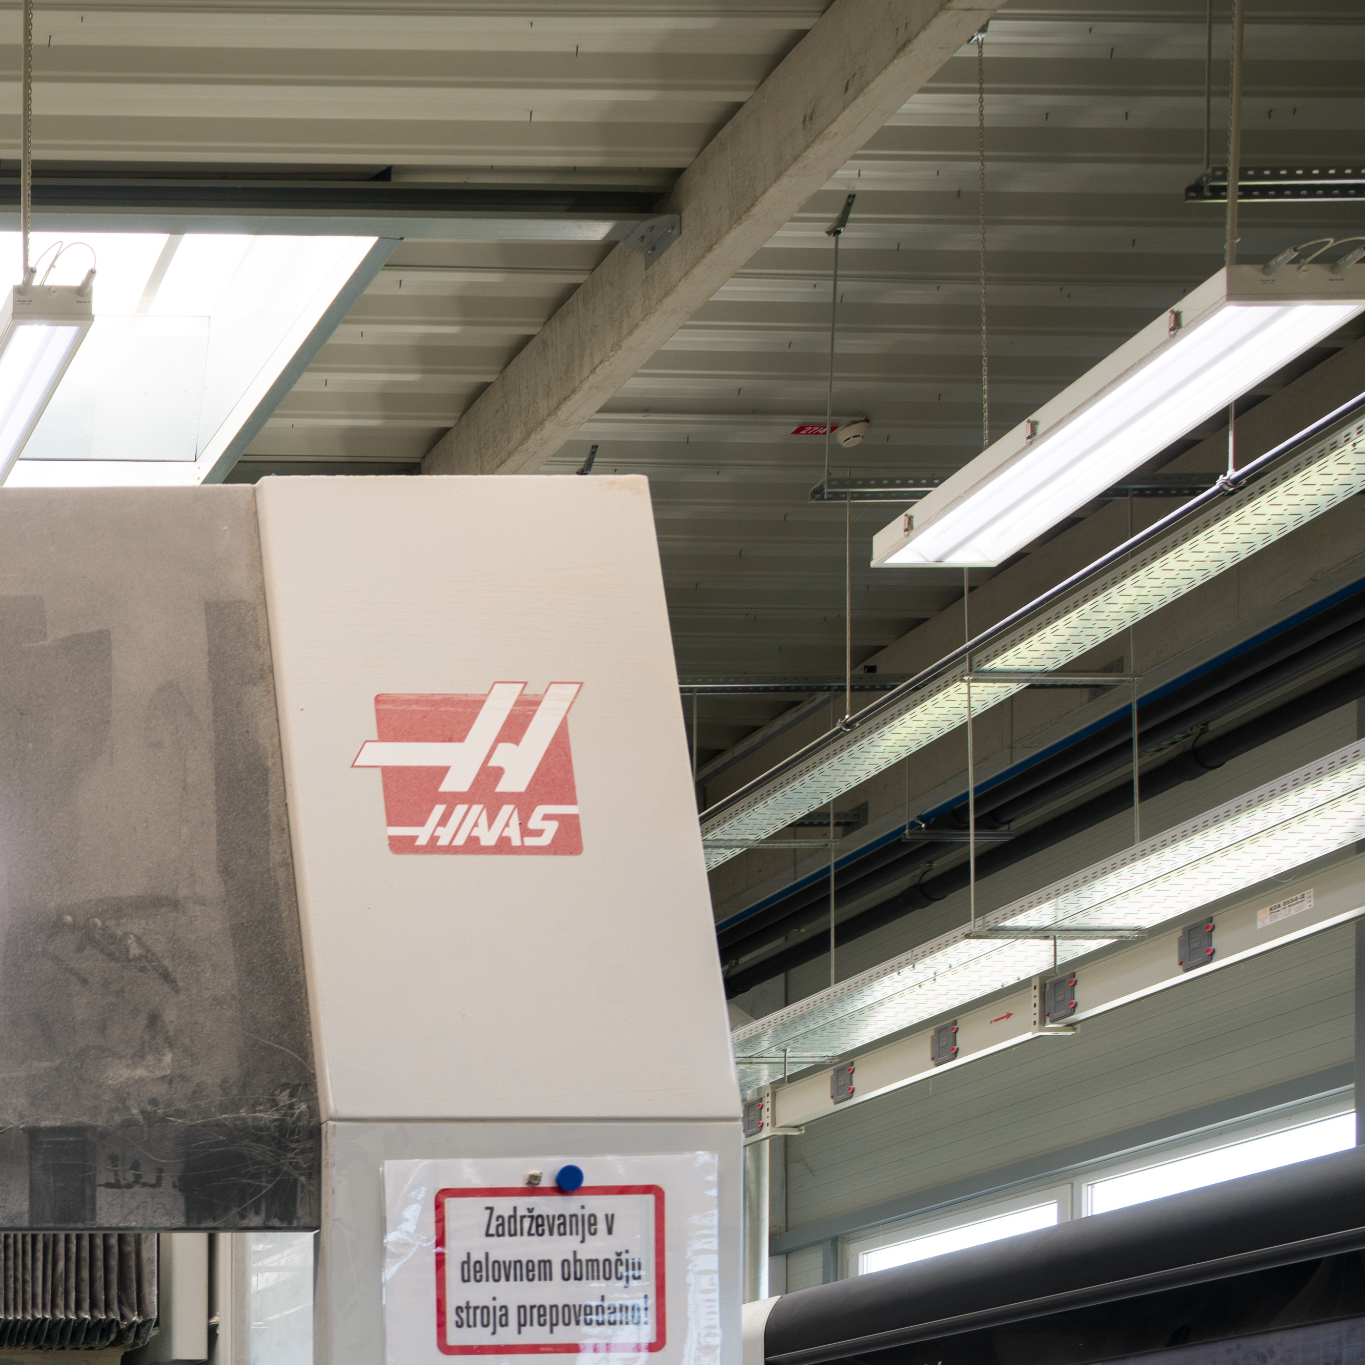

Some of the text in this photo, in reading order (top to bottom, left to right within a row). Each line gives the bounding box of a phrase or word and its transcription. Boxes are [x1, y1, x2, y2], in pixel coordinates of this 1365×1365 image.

[387, 804, 579, 846] HAAS
[484, 1205, 616, 1244] Zadrževanje v
[460, 1249, 642, 1288] delovnem območju
[454, 1294, 650, 1336] stroja prepovedano!
